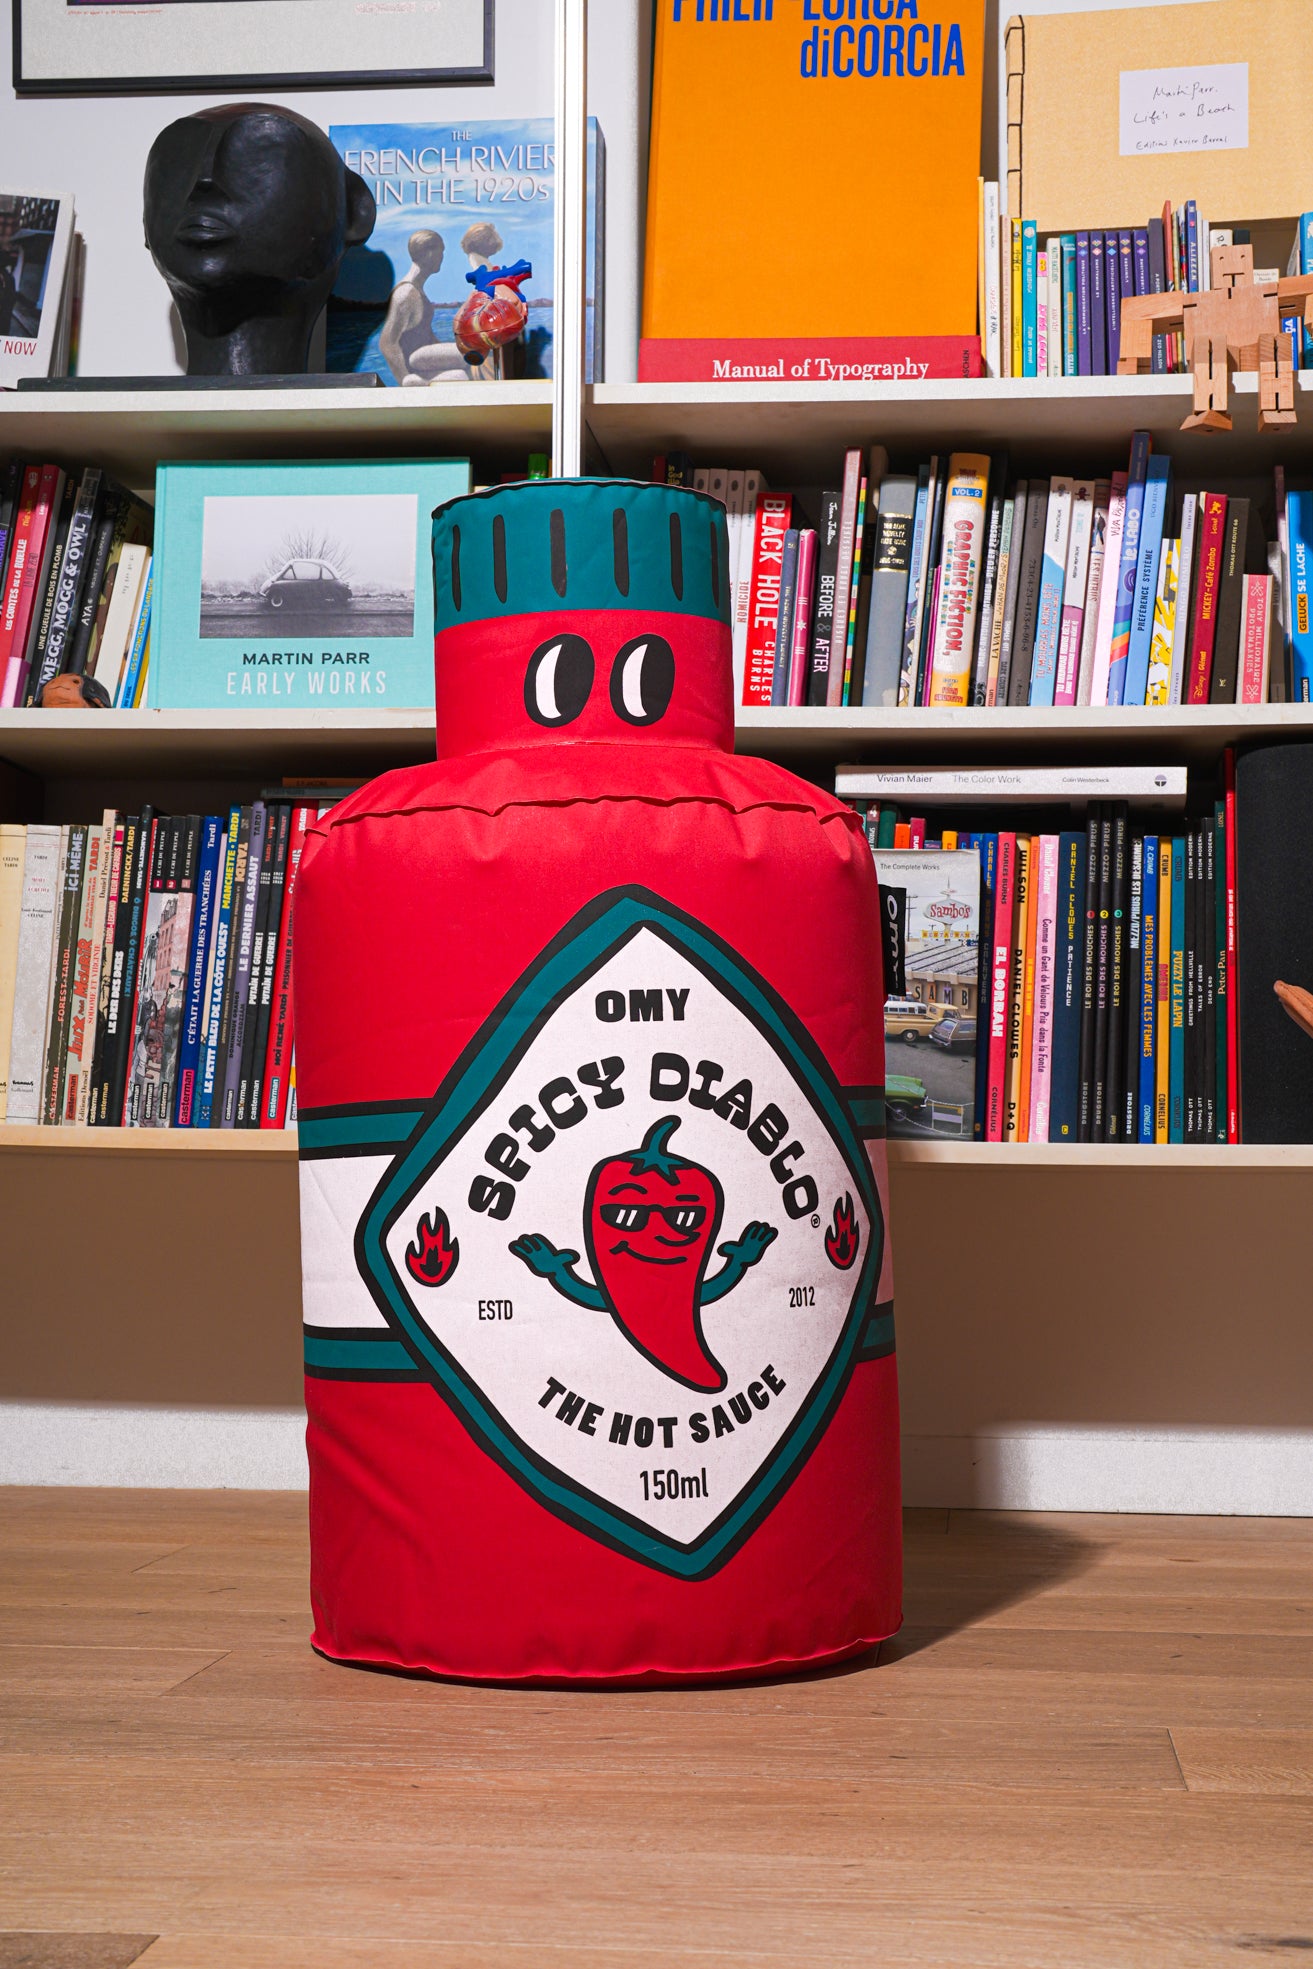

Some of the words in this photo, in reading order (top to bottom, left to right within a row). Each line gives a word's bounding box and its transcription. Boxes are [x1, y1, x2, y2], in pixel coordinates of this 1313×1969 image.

[800, 23, 965, 78] diCORCIA
[451, 131, 472, 142] THE
[345, 147, 459, 176] FRENCH
[375, 178, 404, 206] IN
[411, 177, 462, 205] THE
[472, 176, 550, 203] 1920s
[4, 340, 37, 355] NOW
[712, 358, 785, 378] Manual
[791, 357, 811, 378] of
[815, 357, 929, 381] Typography
[954, 488, 974, 496] VOL.
[68, 523, 86, 560] OWL
[758, 499, 786, 564] BLACK
[989, 510, 1000, 549] PERSONNE
[1126, 508, 1140, 546] LABO
[53, 544, 63, 570] PLOMB
[951, 519, 975, 587] GRAPHIC
[1142, 549, 1153, 584] SYSTÈME
[1206, 547, 1216, 571] Zombo
[1296, 543, 1305, 576] LACHE
[51, 569, 58, 580] EN
[65, 562, 78, 578] &
[1297, 578, 1306, 592] SE
[46, 597, 53, 608] DE
[48, 580, 56, 597] BOIS
[54, 577, 74, 630] MOGG
[736, 579, 750, 623] HOMICIDE
[754, 574, 781, 630] HOLE
[817, 575, 836, 618] BEFORE
[40, 608, 50, 634] GUEULE
[81, 604, 93, 626] AYA
[942, 590, 968, 656] FICTION,
[1137, 586, 1150, 632] PRÉFÉRENCE
[1298, 596, 1308, 631] GELUCK
[38, 634, 46, 650] UNE
[816, 622, 831, 633] &
[41, 631, 64, 682] MEGG,
[243, 653, 313, 665] MARTIN
[321, 652, 370, 665] PARR
[749, 648, 764, 692] BURNS
[813, 637, 830, 673] AFTER
[1253, 624, 1263, 684] MILLIONAIRE
[227, 671, 296, 695] EARLY
[308, 670, 386, 695] WORKS
[760, 640, 776, 702] CHARLES
[877, 774, 906, 783] Vivian
[909, 774, 933, 783] Maier
[952, 774, 969, 783] The
[971, 774, 997, 784] Color
[999, 774, 1022, 783] Work
[207, 823, 216, 849] Tardi
[253, 810, 262, 836] TARDI
[1090, 822, 1098, 848] PIRUS
[1103, 822, 1111, 847] PIRUS
[89, 837, 100, 871] TARDI
[222, 849, 236, 909] MANCHETTE
[229, 812, 239, 843] TARDI
[235, 842, 249, 882] TARDI
[892, 863, 921, 872] Complete
[1002, 842, 1010, 877] CHARLES
[1069, 843, 1077, 889] DANIEL
[1102, 854, 1110, 882] MEZZO
[1161, 854, 1169, 877] CRUMB
[247, 855, 259, 902] ASSAUT
[1018, 850, 1027, 904] WILSON
[199, 869, 212, 928] TRANCHÉES
[929, 903, 971, 919] Sambo's
[241, 903, 254, 956] DERNIER
[1042, 918, 1052, 943] Comme
[1067, 894, 1076, 940] CLOWES
[1144, 915, 1154, 932] MES
[197, 929, 206, 948] DES
[217, 921, 228, 958] OUEST
[1086, 924, 1094, 965] MOUCHES
[1099, 924, 1107, 965] MOUCHES
[1113, 925, 1121, 964] MOUCHES
[112, 951, 124, 978] DERS
[193, 949, 205, 989] GUERRE
[239, 958, 248, 972] LE
[995, 946, 1008, 965] EL
[1144, 933, 1154, 982] PROBLÈMES
[1173, 950, 1183, 982] FUZZY
[1218, 950, 1226, 969] Pan
[110, 977, 120, 999] DES
[213, 958, 225, 988] CÔTE
[1012, 949, 1022, 998] DANIEL
[1066, 945, 1074, 1007] PATIENCE
[1085, 966, 1093, 981] DES
[1218, 970, 1226, 995] Peter
[212, 987, 223, 1003] LA
[595, 988, 690, 1023] OMY
[991, 968, 1007, 1037] BORBAH
[1039, 984, 1050, 1010] Velours
[1143, 983, 1153, 1005] AVEC
[1173, 983, 1183, 996] LE
[108, 999, 119, 1021] DER
[211, 1003, 221, 1019] DE
[278, 993, 288, 1020] TARDI
[1143, 1006, 1152, 1022] LES
[1173, 998, 1183, 1028] LAPIN
[68, 1015, 85, 1062] JEUX
[187, 1004, 199, 1045] C'ÉTAIT
[208, 1019, 219, 1047] BLEU
[1010, 1002, 1020, 1059] CLOWES
[1039, 1027, 1049, 1043] dans
[1143, 1023, 1152, 1058] FEMMES
[205, 1048, 216, 1079] PETIT
[1037, 1053, 1048, 1073] Fonte
[67, 1076, 77, 1119] casterman
[131, 1085, 139, 1119] casterman
[145, 1084, 153, 1118] casterman
[160, 1083, 168, 1117] casterman
[181, 1071, 192, 1123] casterman
[203, 1080, 213, 1094] LE
[251, 1080, 260, 1120] casterman
[268, 1079, 278, 1118] casterman
[90, 1088, 98, 1123] casterman
[468, 1055, 625, 1221] SPICY
[478, 1299, 513, 1321] ESTD
[788, 1286, 816, 1308] 2012
[537, 1376, 604, 1437] THE
[608, 1411, 678, 1448] HOT
[689, 1363, 787, 1443] SAUCE
[640, 1467, 709, 1501] 150ml
